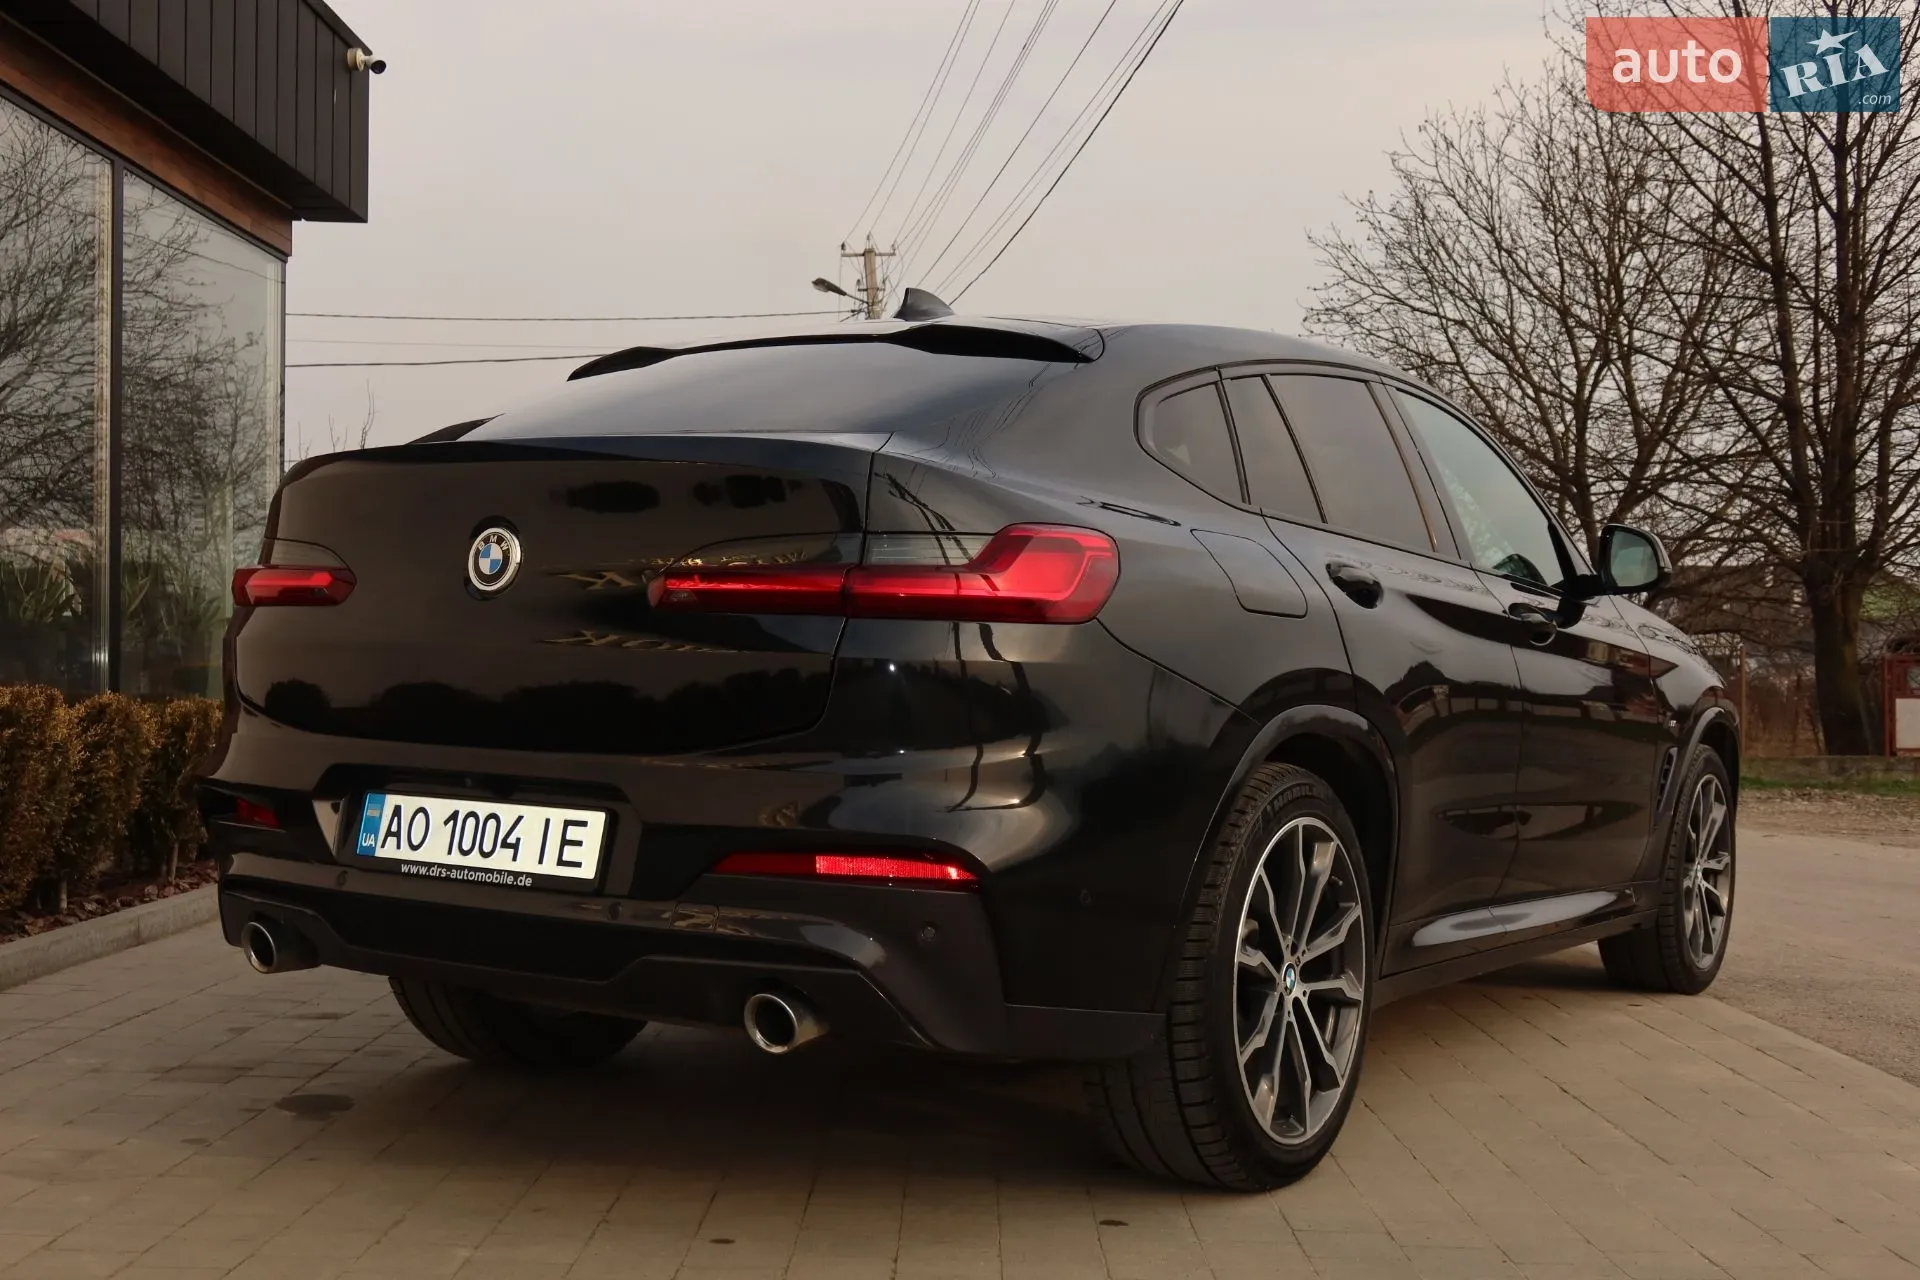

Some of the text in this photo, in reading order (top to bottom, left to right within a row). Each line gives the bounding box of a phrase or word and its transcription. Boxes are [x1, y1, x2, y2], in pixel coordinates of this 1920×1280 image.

[477, 534, 509, 551] BMW
[361, 832, 376, 848] UA
[380, 804, 589, 868] AO 1004 IE
[400, 863, 533, 887] www.drs-automobile.de
